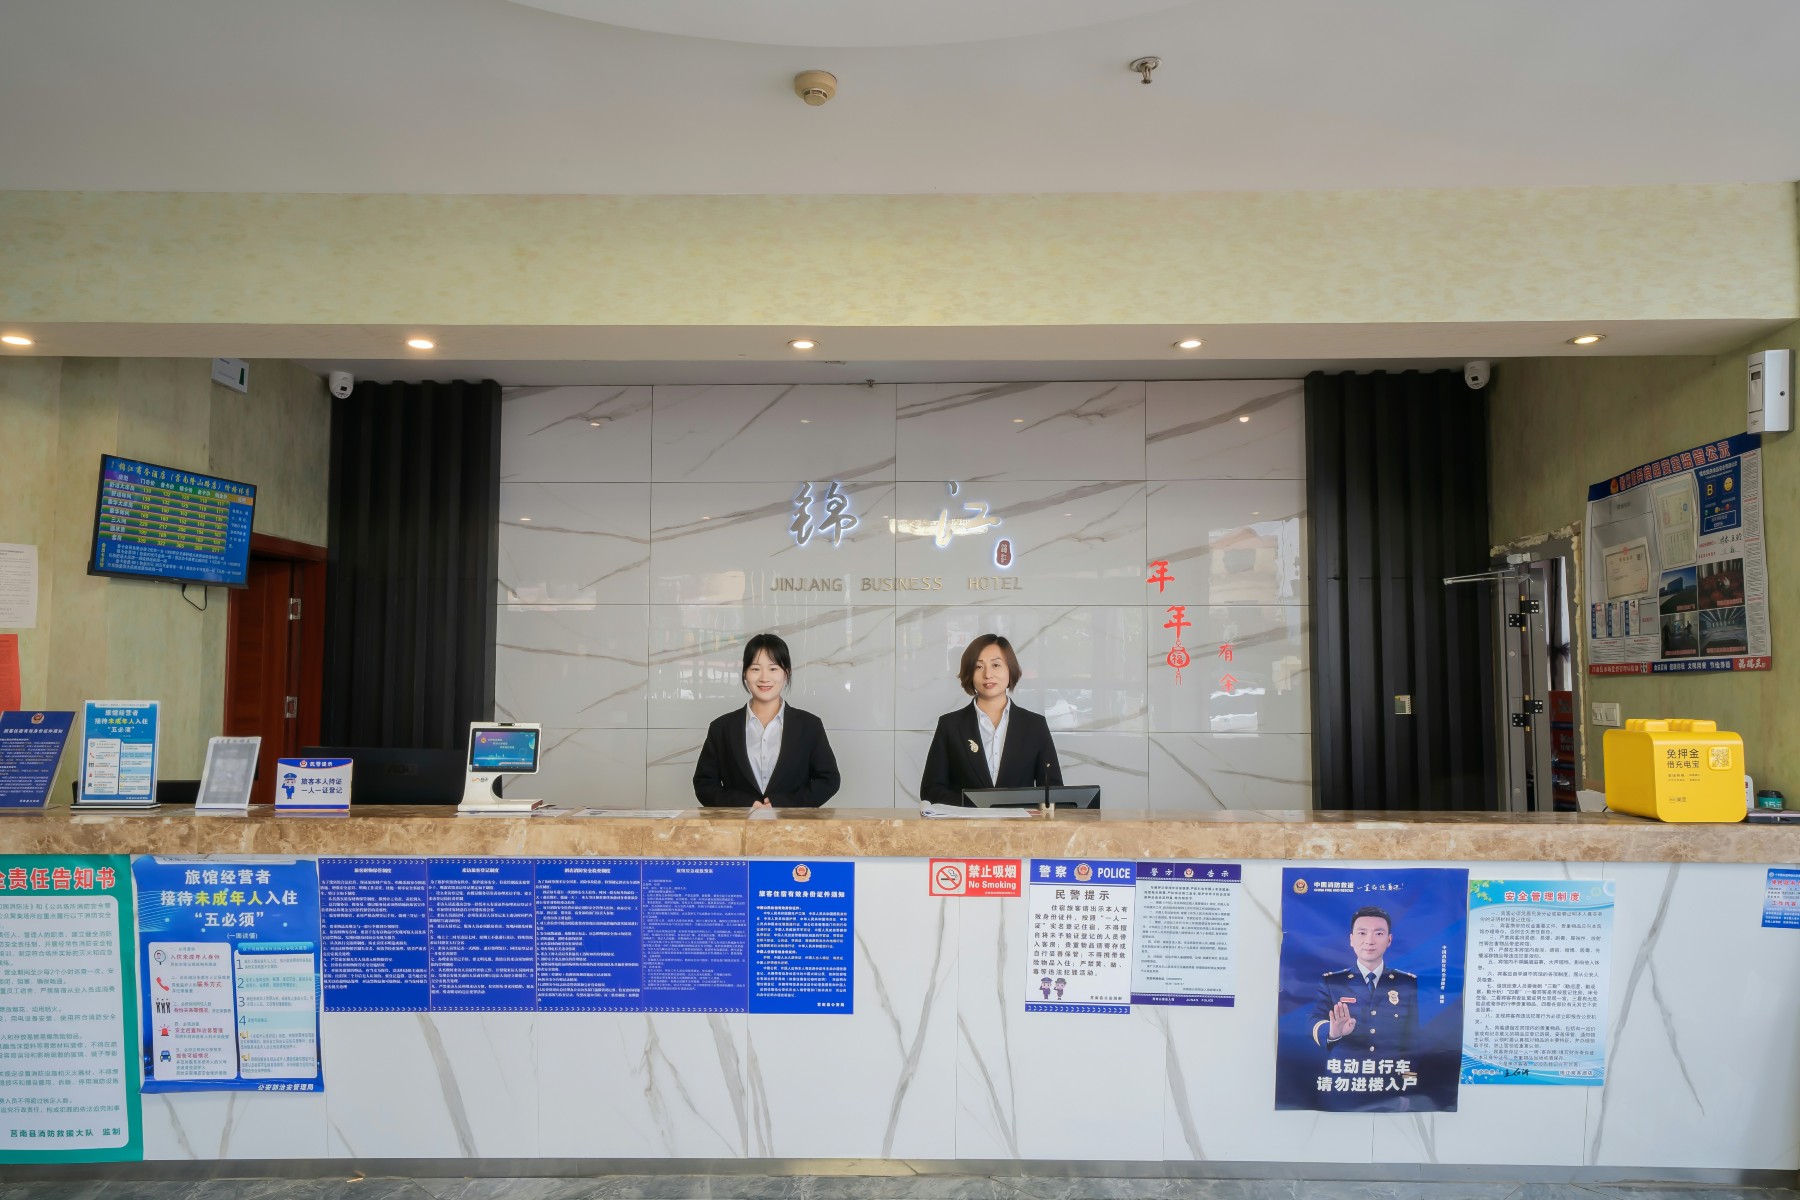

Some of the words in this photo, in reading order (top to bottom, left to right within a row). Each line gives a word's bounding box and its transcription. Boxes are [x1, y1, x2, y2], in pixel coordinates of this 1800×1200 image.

[1706, 484, 1713, 497] B
[770, 578, 843, 592] JINJIANG
[860, 577, 943, 592] BUSINESS
[968, 576, 1023, 591] HOTEL
[1218, 644, 1234, 662] 有
[1667, 748, 1700, 759] 免押金
[1667, 761, 1700, 769] 借充电宝
[185, 869, 272, 885] 旅馆经营者
[968, 864, 1017, 879] 禁止吸烟
[1039, 865, 1067, 878] 警察
[1098, 868, 1131, 879] POLICE
[1150, 868, 1173, 877] 警方
[1207, 869, 1230, 878] 告示
[968, 881, 980, 889] No
[982, 881, 1017, 890] Smoking
[160, 890, 299, 907] 接待未成年人入住
[759, 890, 846, 898] 旅客住宿有效身份证件须知
[1056, 890, 1110, 901] 民警提示
[1505, 891, 1581, 902] 安全管理制度
[1051, 905, 1128, 913] 住宿旅客请出示本人有
[195, 912, 265, 927] “五必须”
[237, 960, 244, 970] 1
[238, 978, 245, 989] 2
[239, 997, 246, 1007] 3
[239, 1016, 246, 1026] 4
[1327, 1059, 1411, 1075] 电动自行车
[1316, 1076, 1418, 1092] 请勿进楼入户
[10, 1128, 94, 1138] 莒南县消防救援大队
[103, 1128, 121, 1136] 监制
